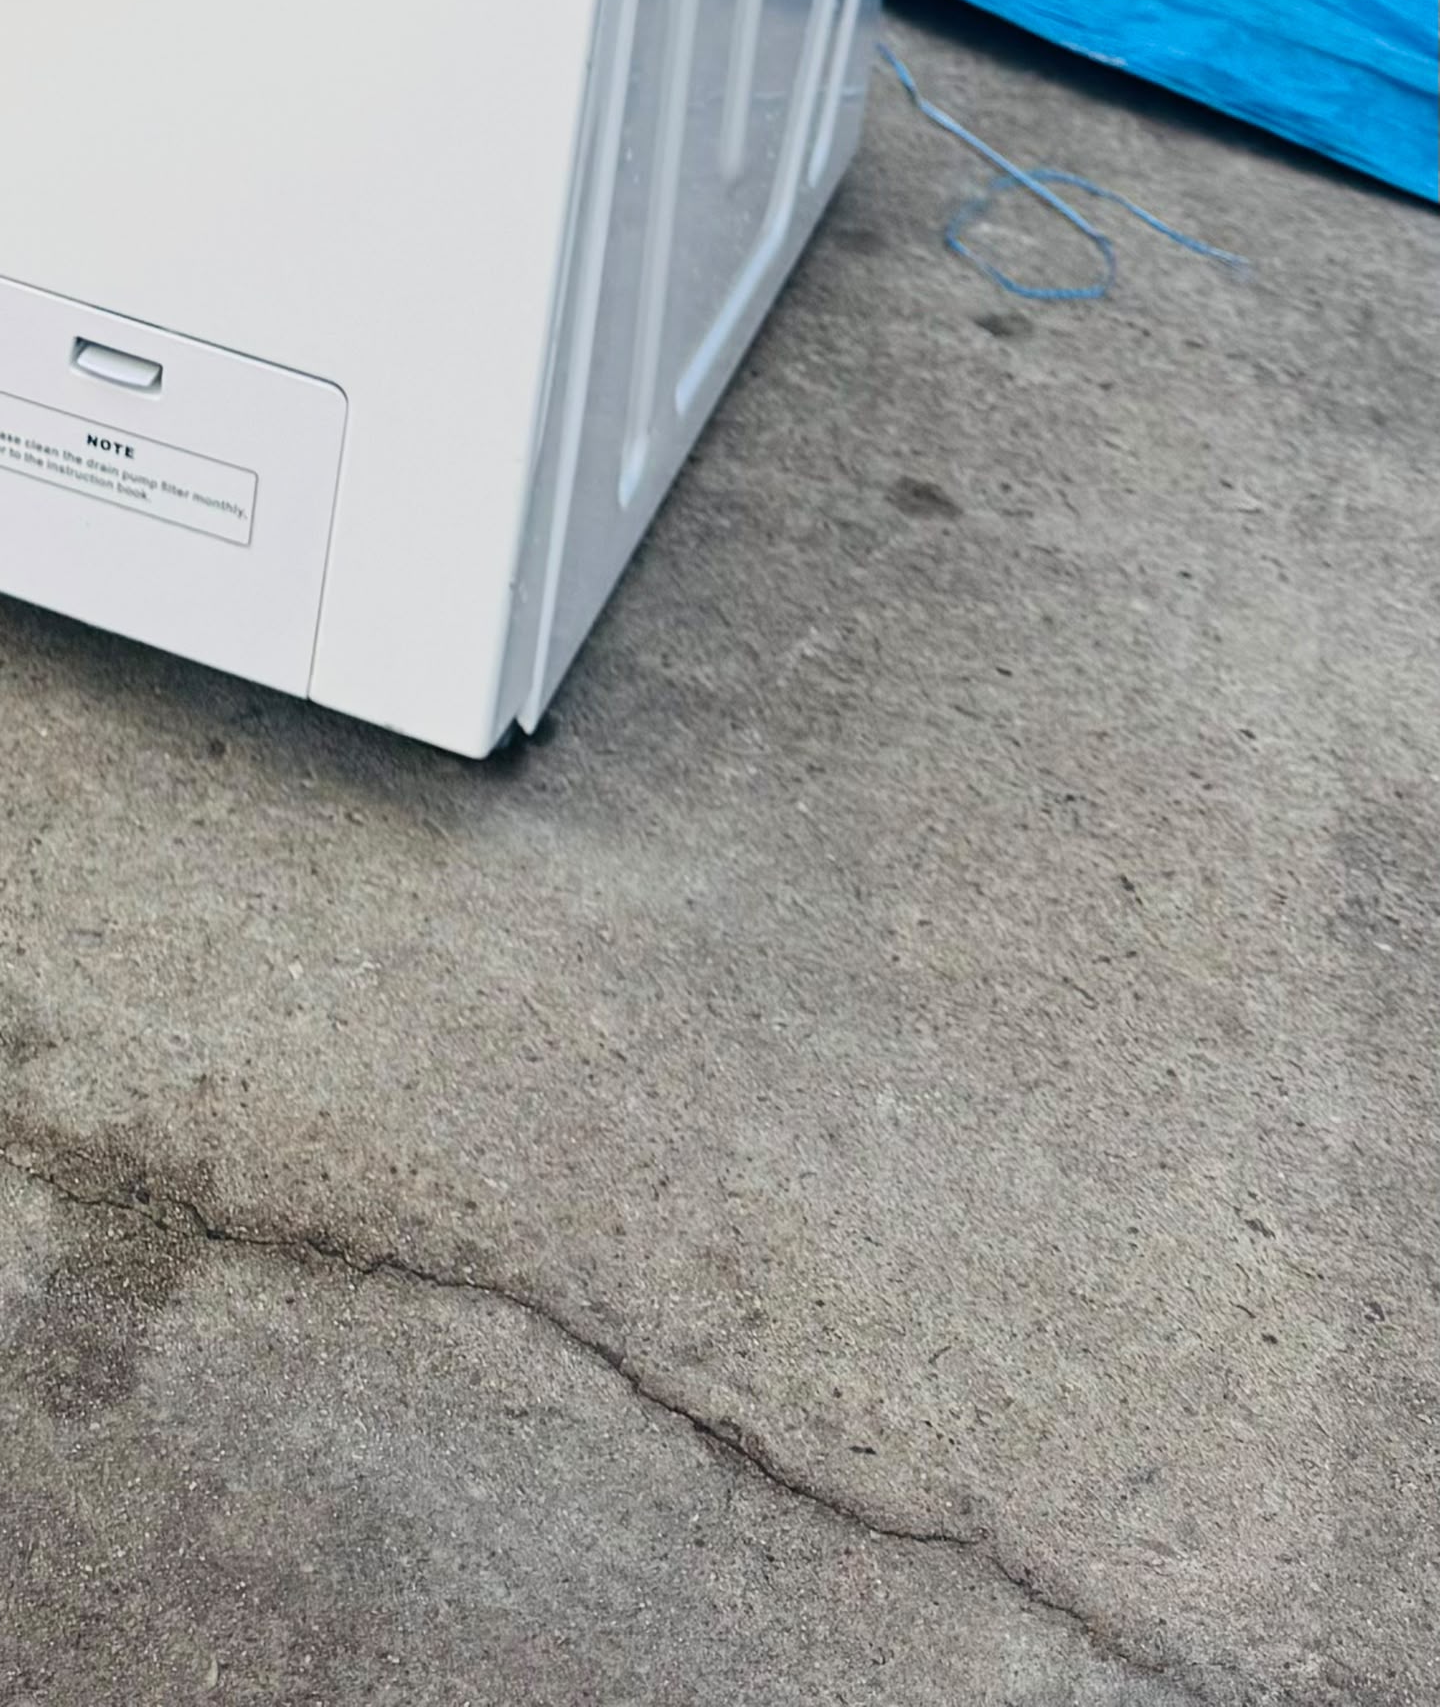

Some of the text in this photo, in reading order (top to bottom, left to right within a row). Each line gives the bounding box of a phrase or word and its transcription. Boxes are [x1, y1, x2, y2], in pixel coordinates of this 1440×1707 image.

[25, 438, 59, 457] clean
[63, 450, 83, 465] the
[86, 458, 119, 477] drain
[122, 470, 158, 491] pump
[86, 433, 135, 460] NOTE
[9, 447, 21, 460] to
[24, 452, 44, 467] the
[46, 459, 114, 490] instruction
